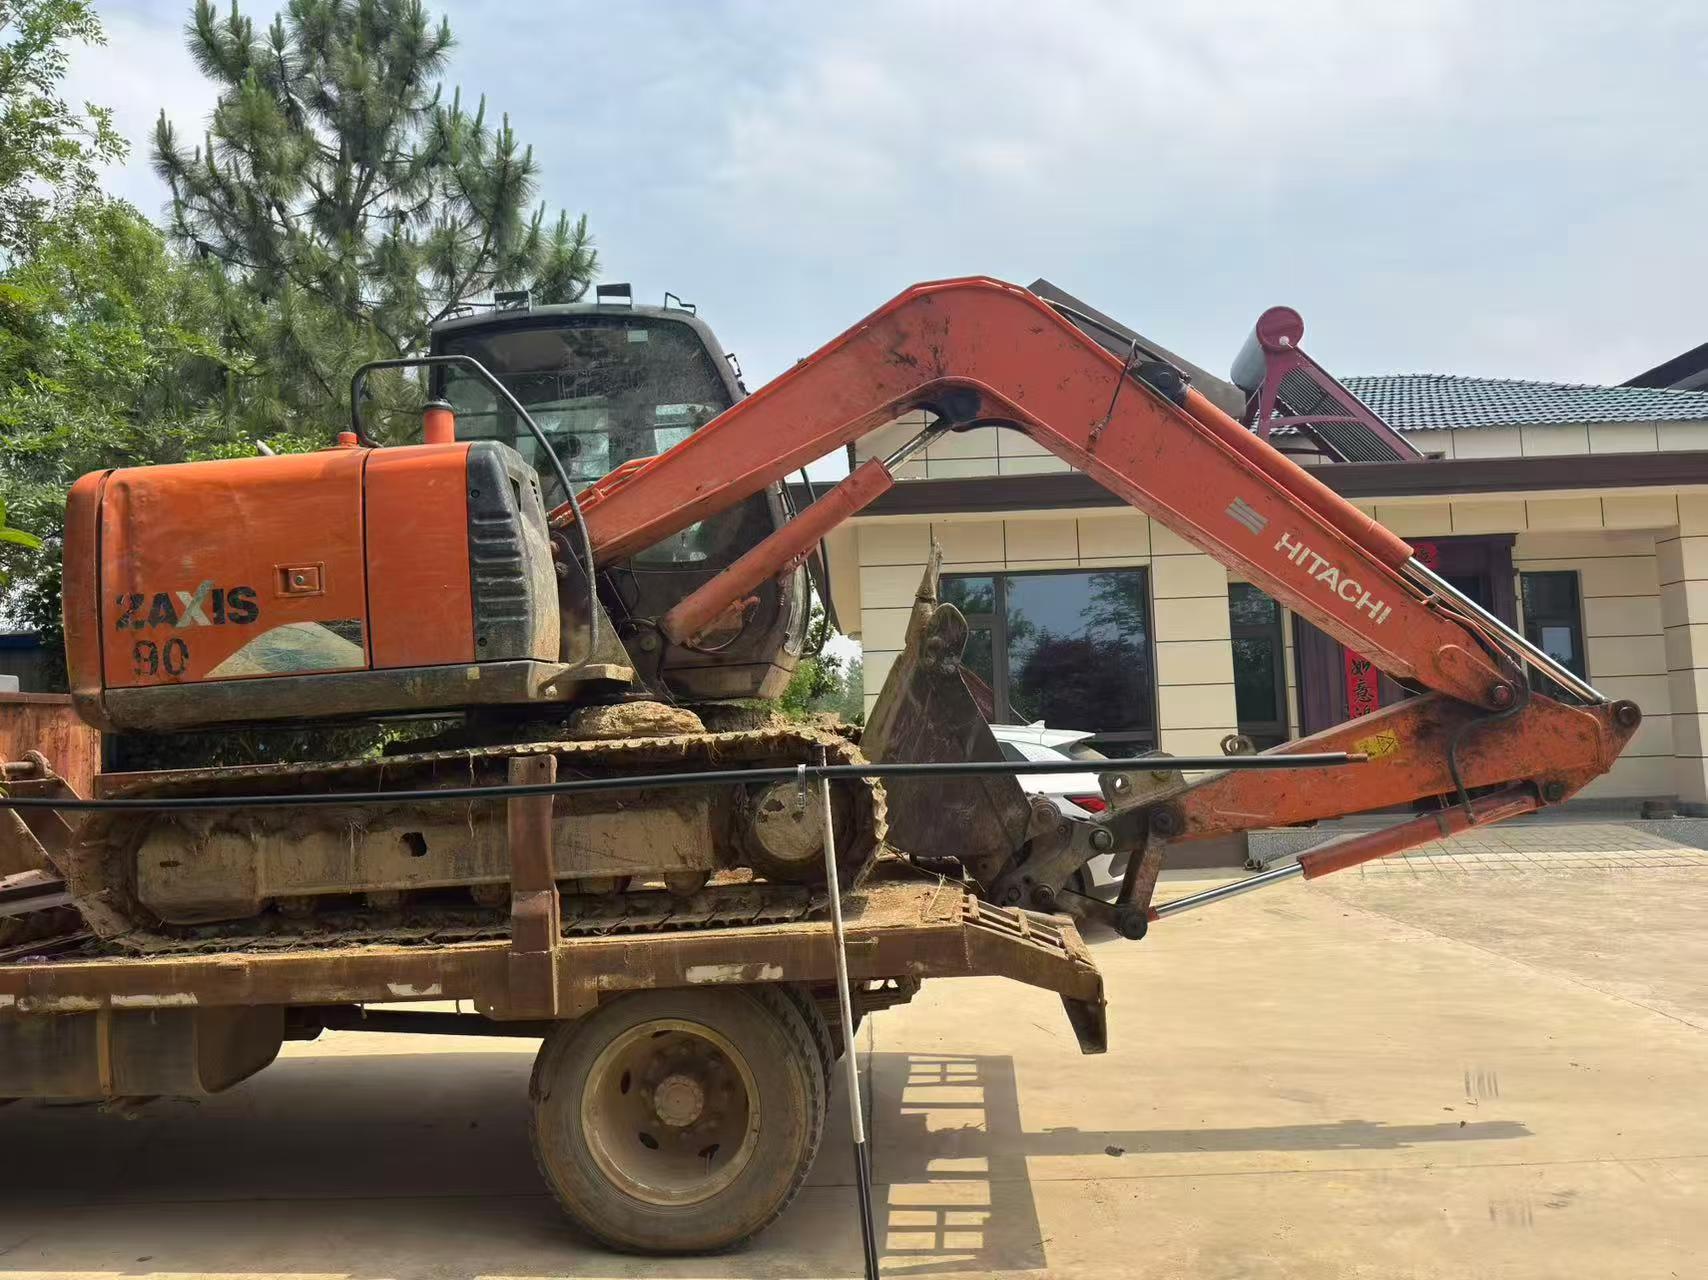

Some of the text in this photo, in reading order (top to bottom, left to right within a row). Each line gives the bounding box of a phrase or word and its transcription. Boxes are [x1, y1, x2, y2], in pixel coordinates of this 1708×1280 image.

[1273, 531, 1393, 625] HITACHI
[115, 579, 260, 631] ZAXIS
[133, 637, 190, 676] 90
